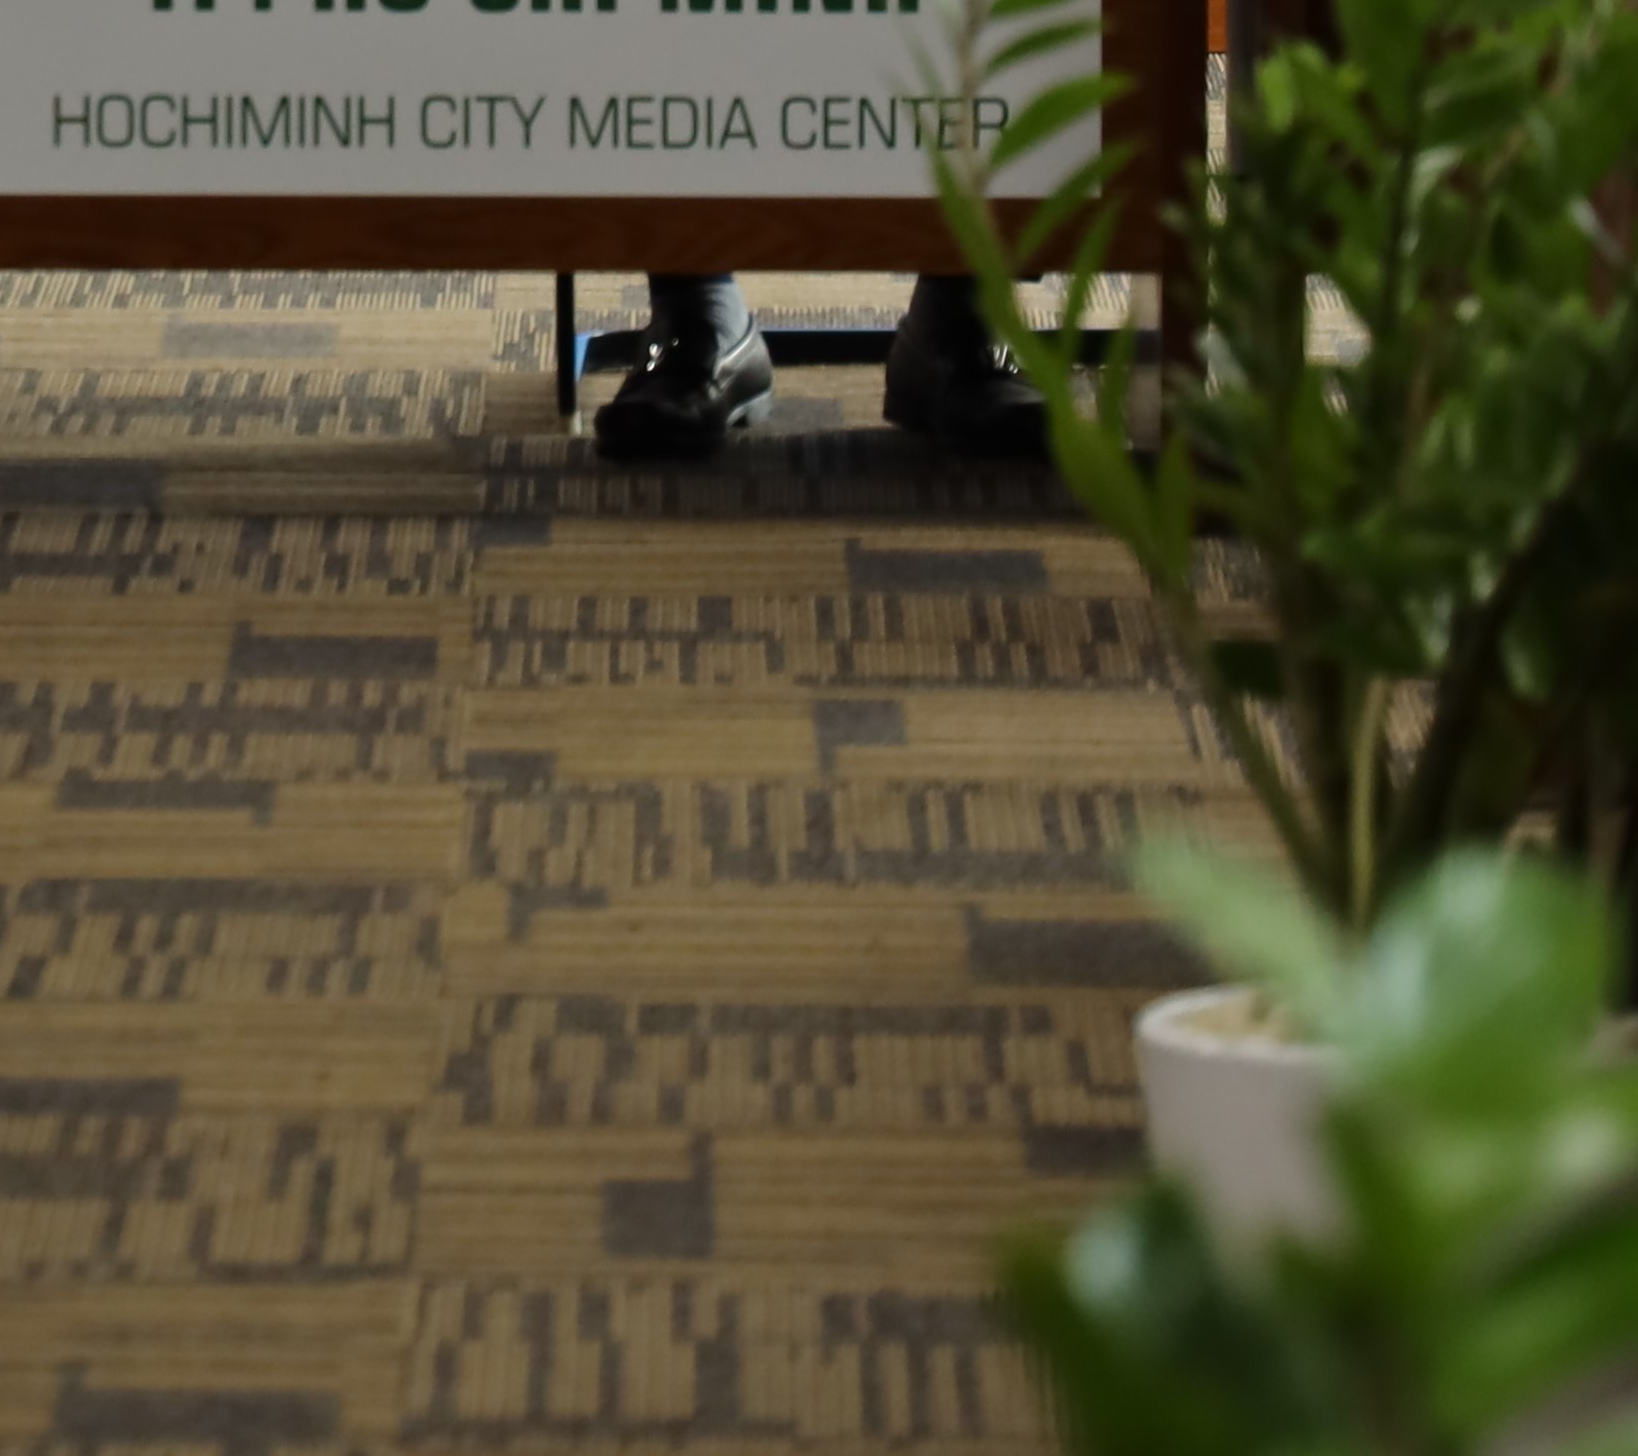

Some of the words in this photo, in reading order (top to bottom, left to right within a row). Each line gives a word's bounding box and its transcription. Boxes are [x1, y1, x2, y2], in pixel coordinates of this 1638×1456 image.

[52, 93, 396, 150] HOCHIMINH
[419, 93, 546, 150] CITY
[568, 94, 759, 151] MEDIA
